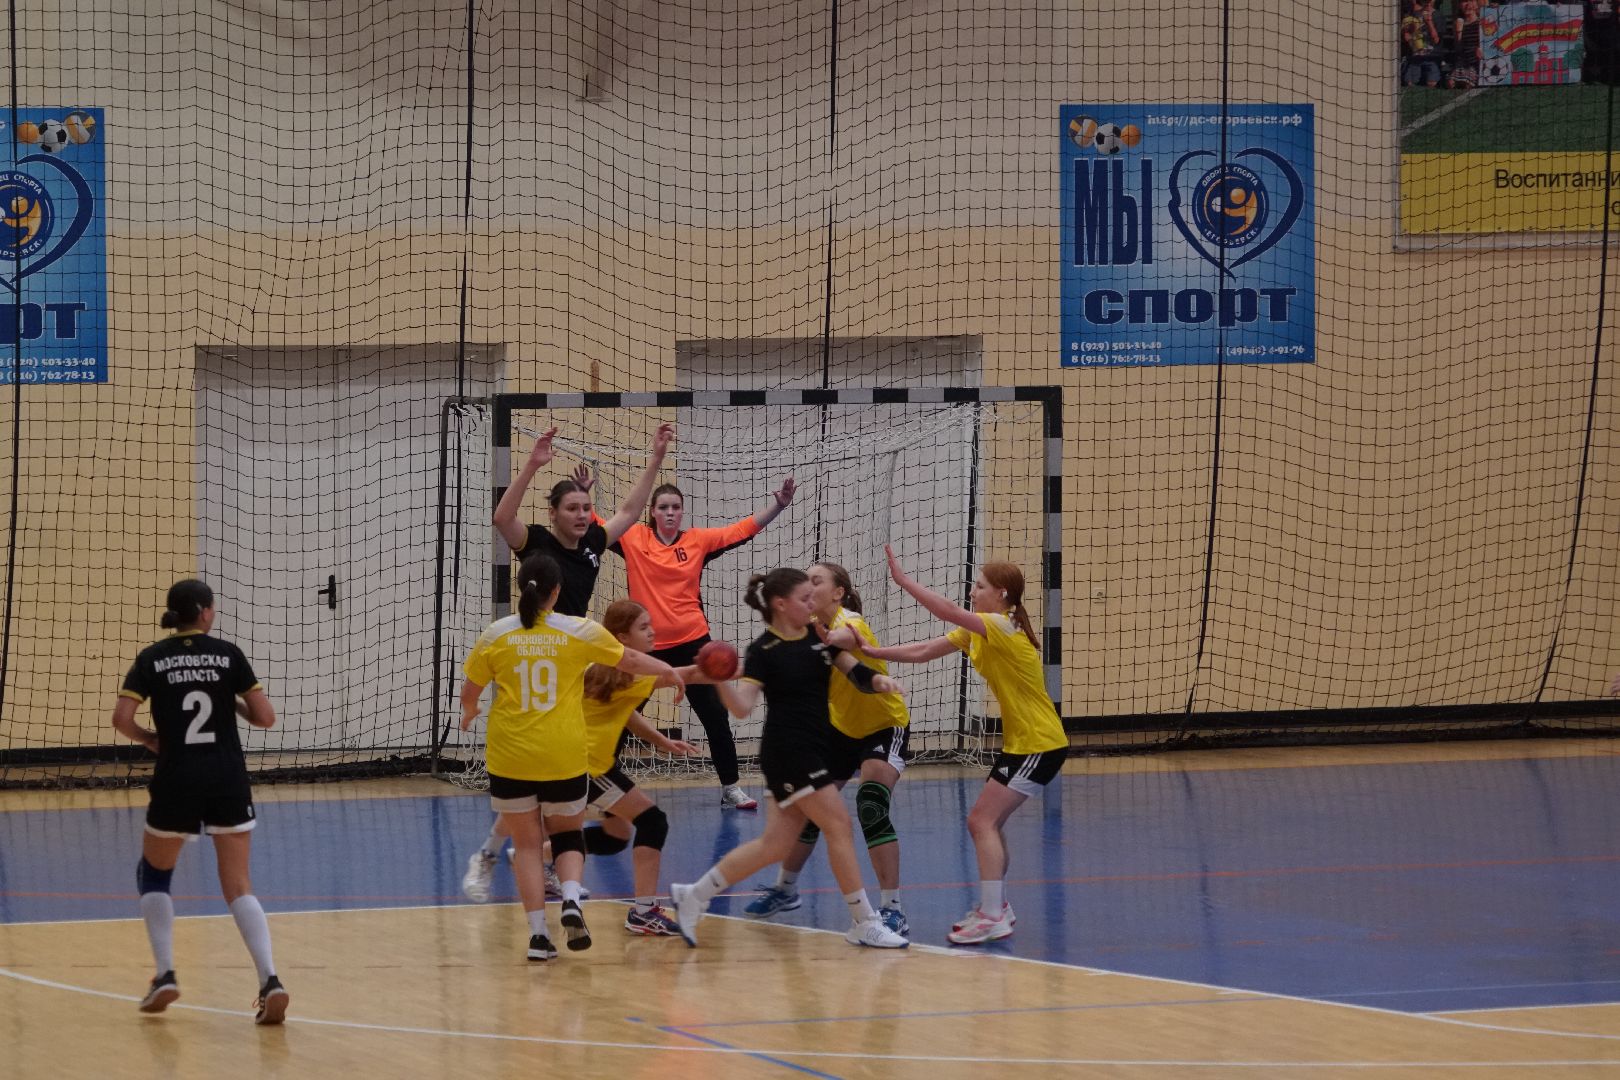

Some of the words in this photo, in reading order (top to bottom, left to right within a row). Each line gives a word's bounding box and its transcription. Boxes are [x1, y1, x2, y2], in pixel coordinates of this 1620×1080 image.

[1073, 158, 1153, 267] МЫ
[674, 547, 688, 563] 16
[507, 634, 568, 646] МОСКОВСКАЯ
[517, 645, 558, 656] ОБЛАСТЬ
[153, 655, 231, 673] МОСКОВСКАЯ
[167, 669, 220, 684] ОБЛАСТЬ
[513, 659, 558, 712] 19
[182, 690, 216, 744] 2
